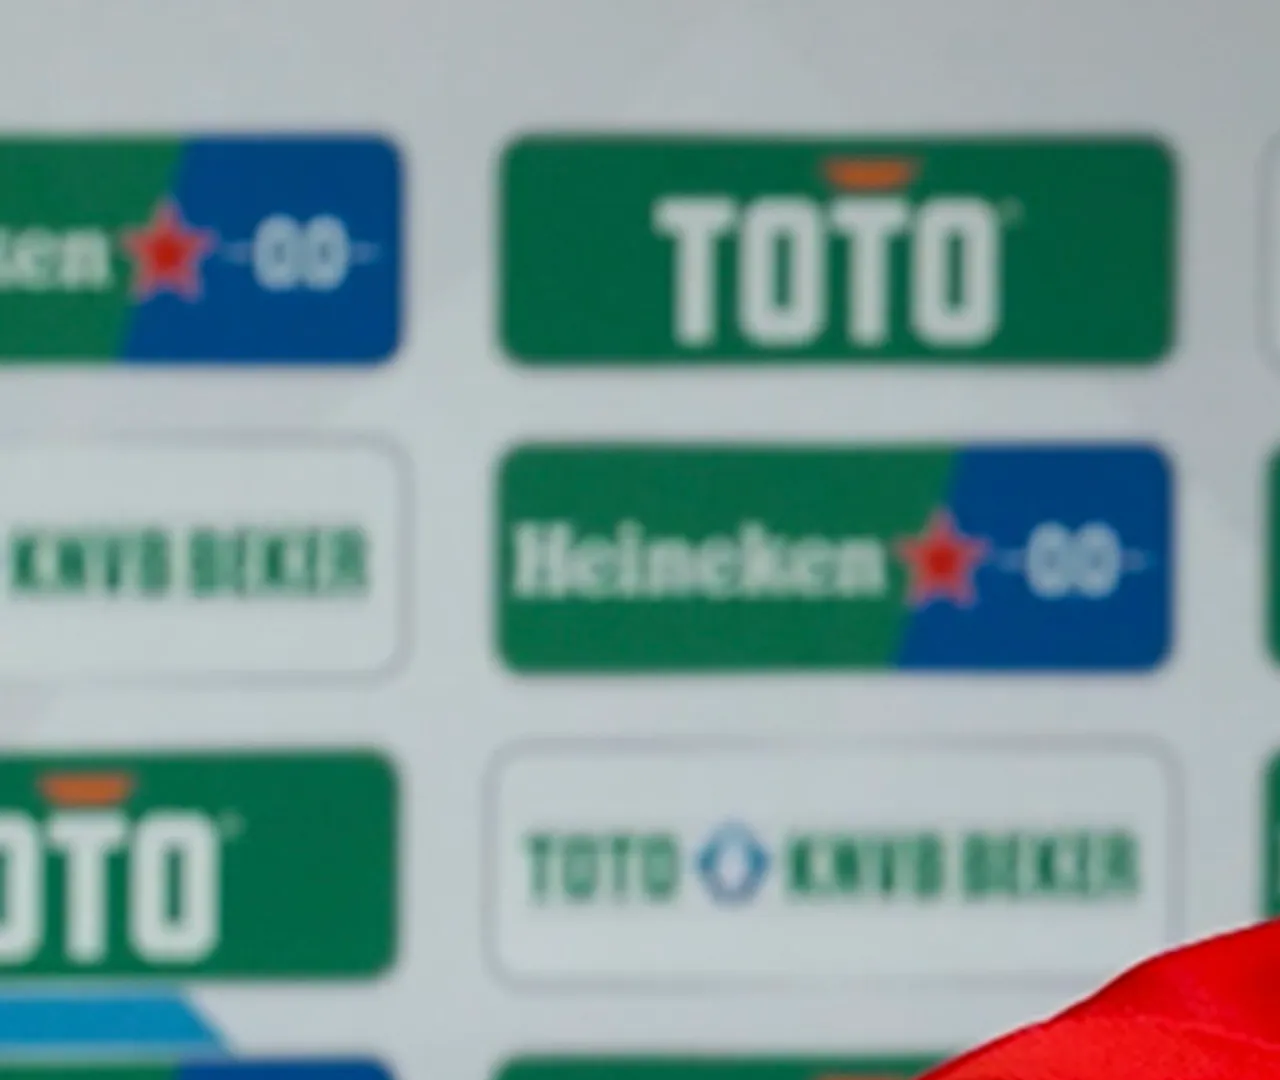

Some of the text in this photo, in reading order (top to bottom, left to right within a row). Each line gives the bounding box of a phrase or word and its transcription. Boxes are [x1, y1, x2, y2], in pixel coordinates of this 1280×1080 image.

[0, 227, 113, 291] en
[652, 195, 1000, 347] TOTO
[8, 526, 369, 598] KNVB BEKER
[511, 519, 888, 600] Heineken
[524, 830, 1141, 904] TOTO KNVB BEKER
